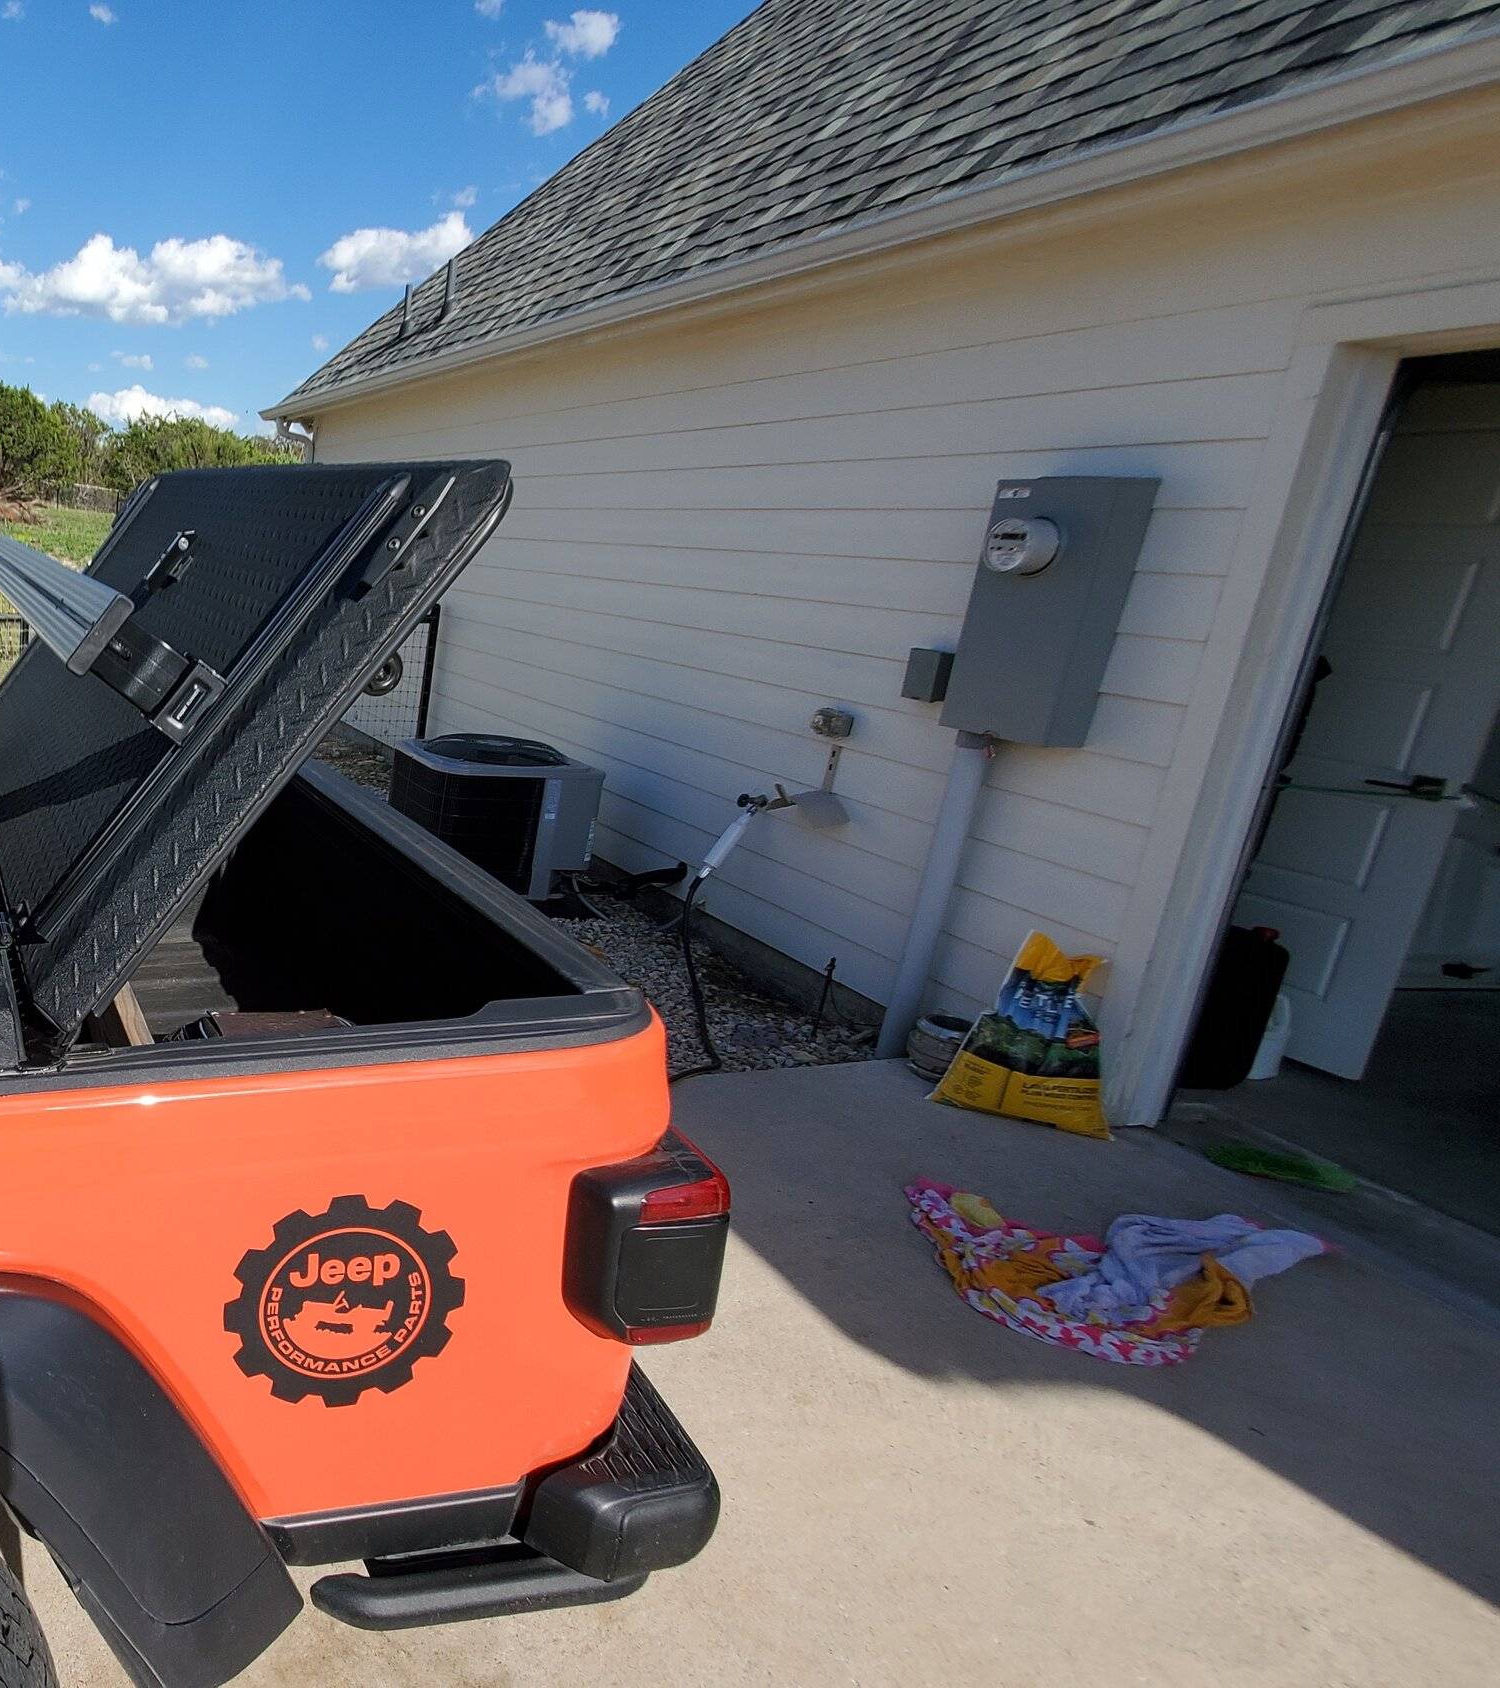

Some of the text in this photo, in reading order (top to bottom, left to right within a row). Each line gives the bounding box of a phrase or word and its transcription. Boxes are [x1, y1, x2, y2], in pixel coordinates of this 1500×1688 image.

[289, 1253, 401, 1288] Jeep
[266, 1271, 422, 1373] PERFORMANCE PARTS
